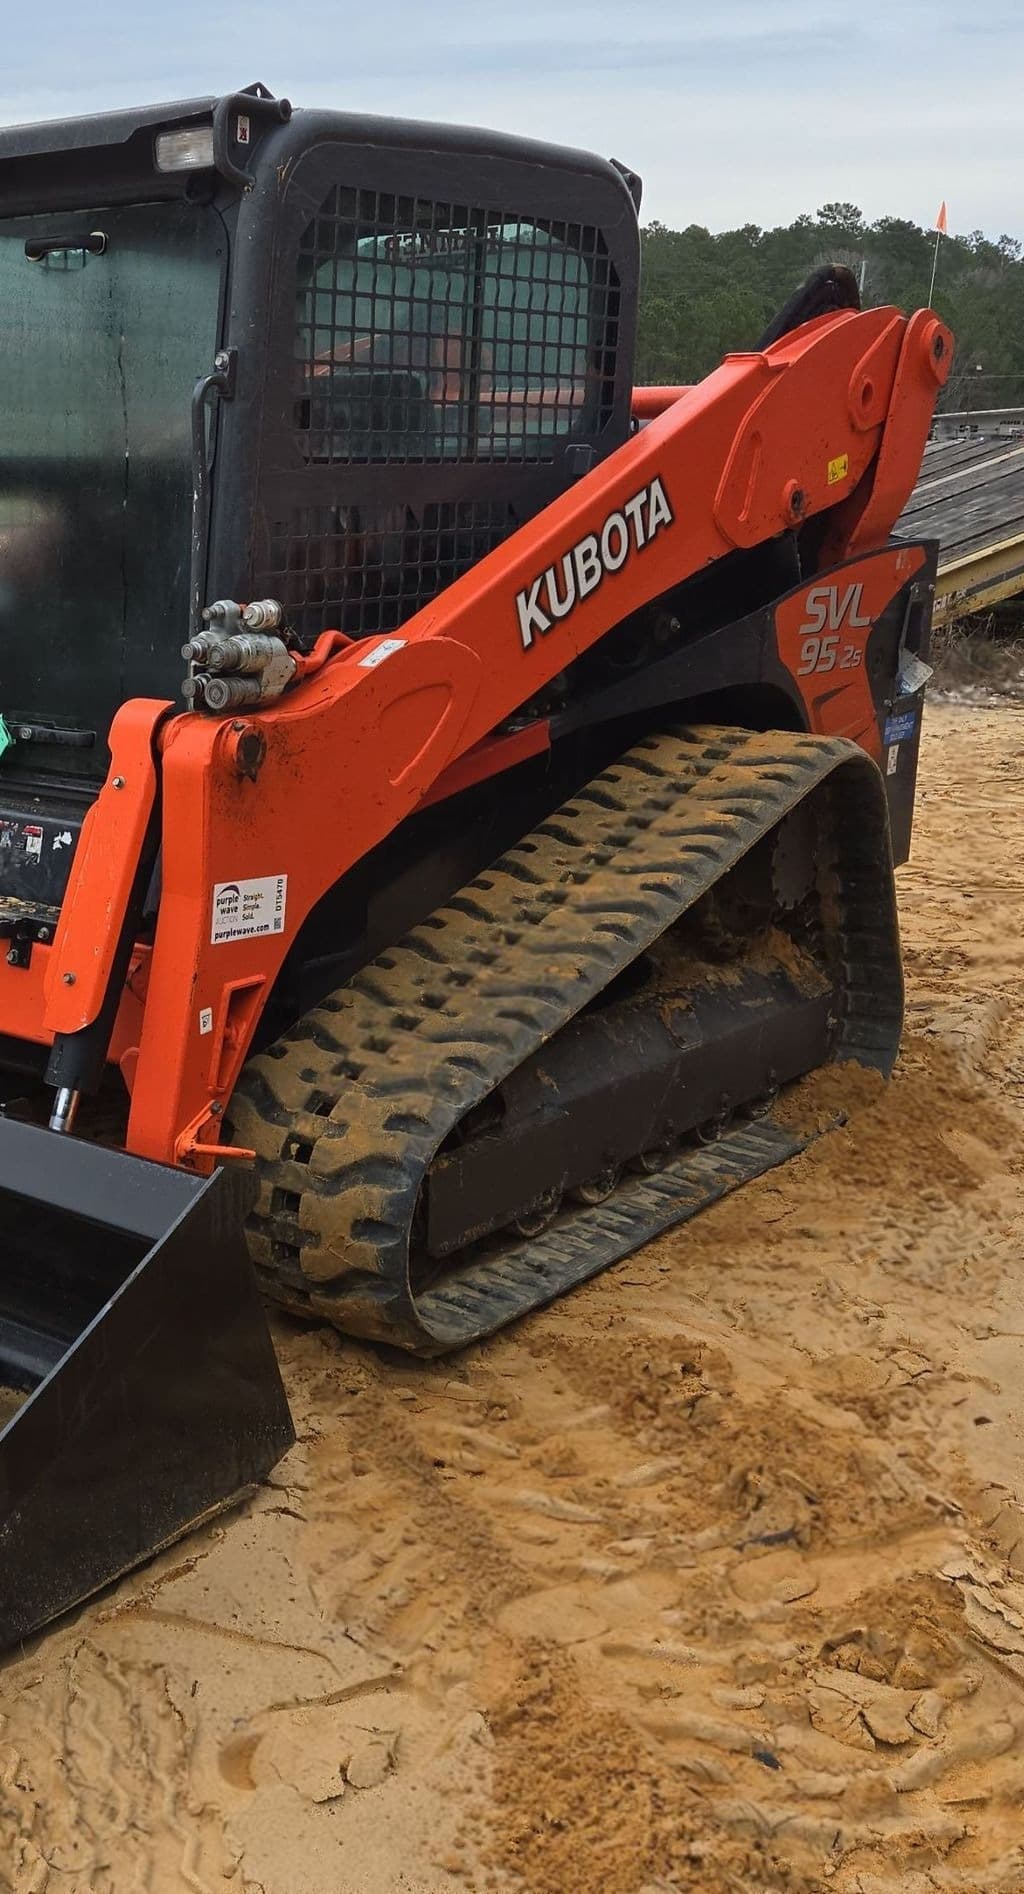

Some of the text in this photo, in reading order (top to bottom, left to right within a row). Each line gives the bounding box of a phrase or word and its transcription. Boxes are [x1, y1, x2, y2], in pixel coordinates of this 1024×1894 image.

[515, 476, 674, 649] KUBOTA
[799, 583, 871, 635] SVL
[797, 635, 840, 676] 95
[216, 893, 239, 908] purple
[220, 905, 238, 915] wave
[214, 924, 270, 942] purplewave.com
